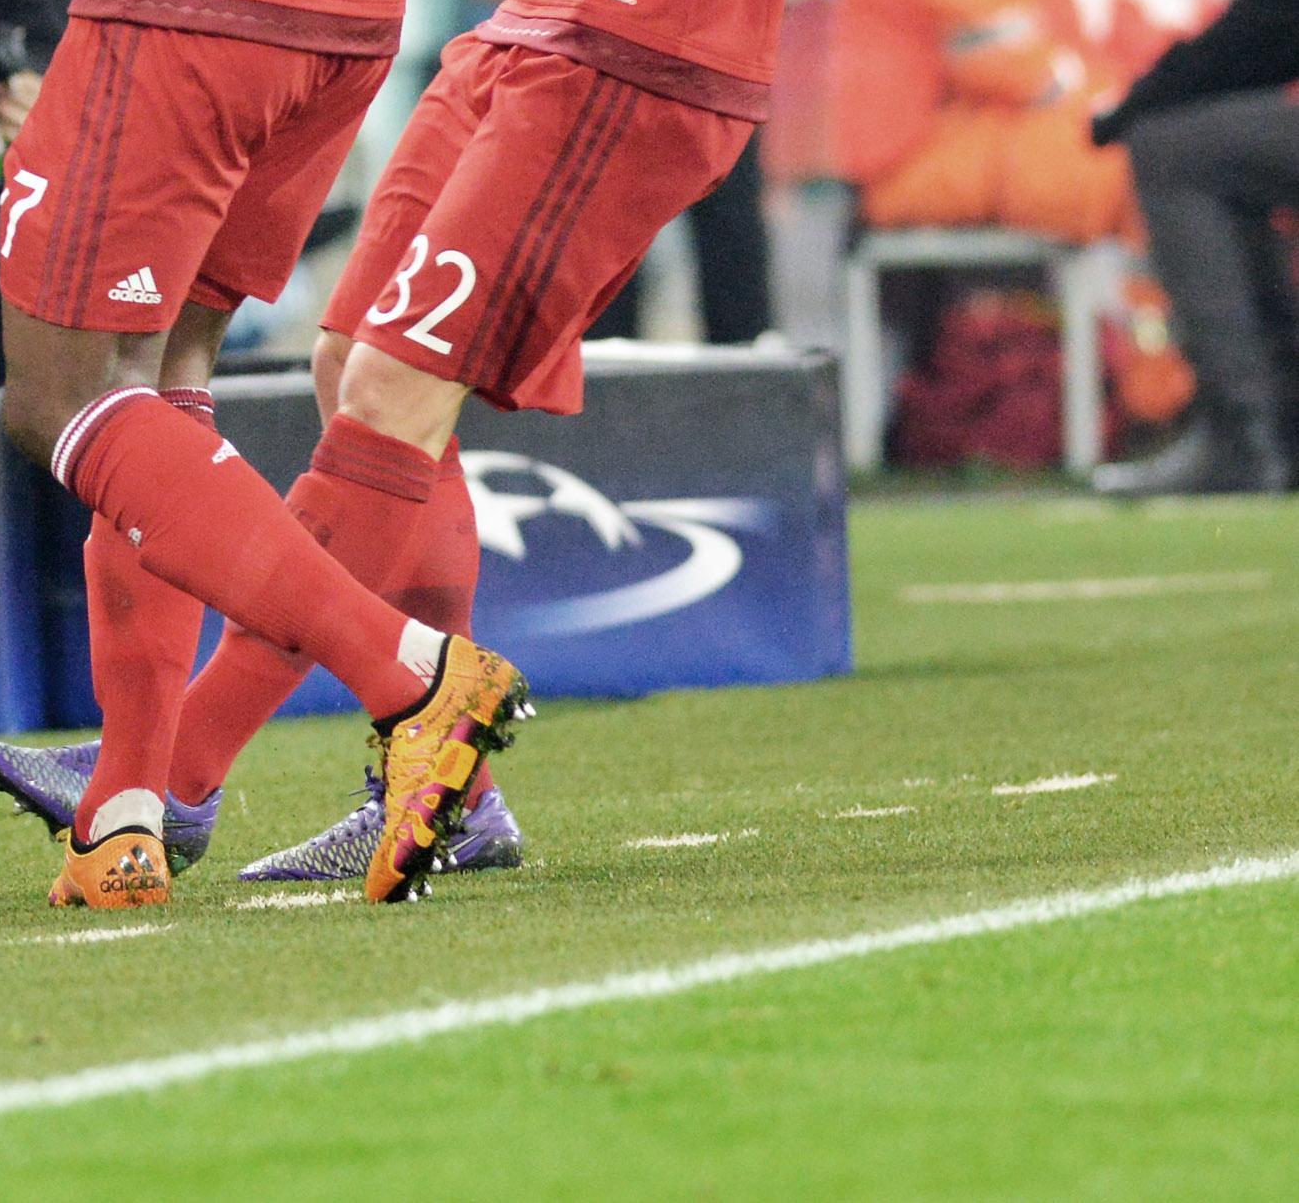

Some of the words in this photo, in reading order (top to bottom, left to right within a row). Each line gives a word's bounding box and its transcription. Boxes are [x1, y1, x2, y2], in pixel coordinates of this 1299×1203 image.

[0, 169, 49, 259] 7
[108, 288, 163, 305] adidas
[365, 234, 477, 355] 32
